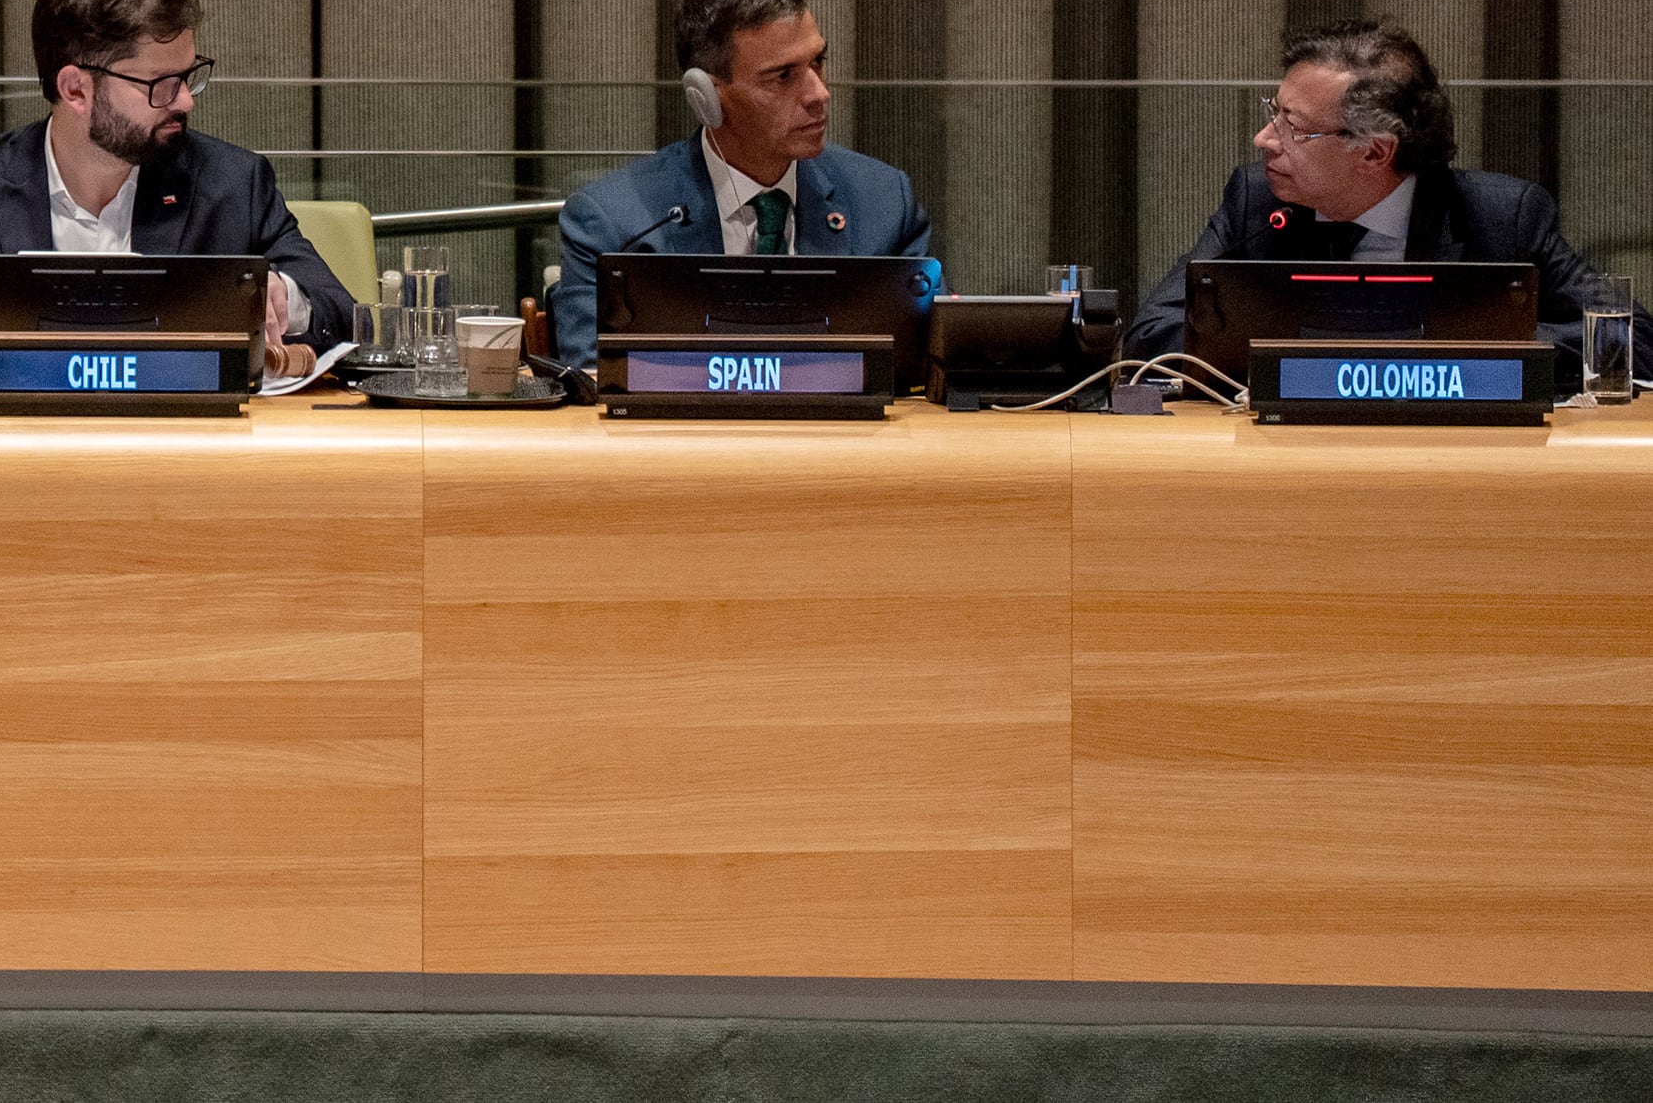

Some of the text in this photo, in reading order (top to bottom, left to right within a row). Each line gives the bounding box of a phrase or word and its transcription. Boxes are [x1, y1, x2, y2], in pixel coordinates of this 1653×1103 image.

[68, 355, 137, 389] CHILE
[708, 356, 781, 391] SPAIN
[1337, 363, 1465, 398] COLOMBIA
